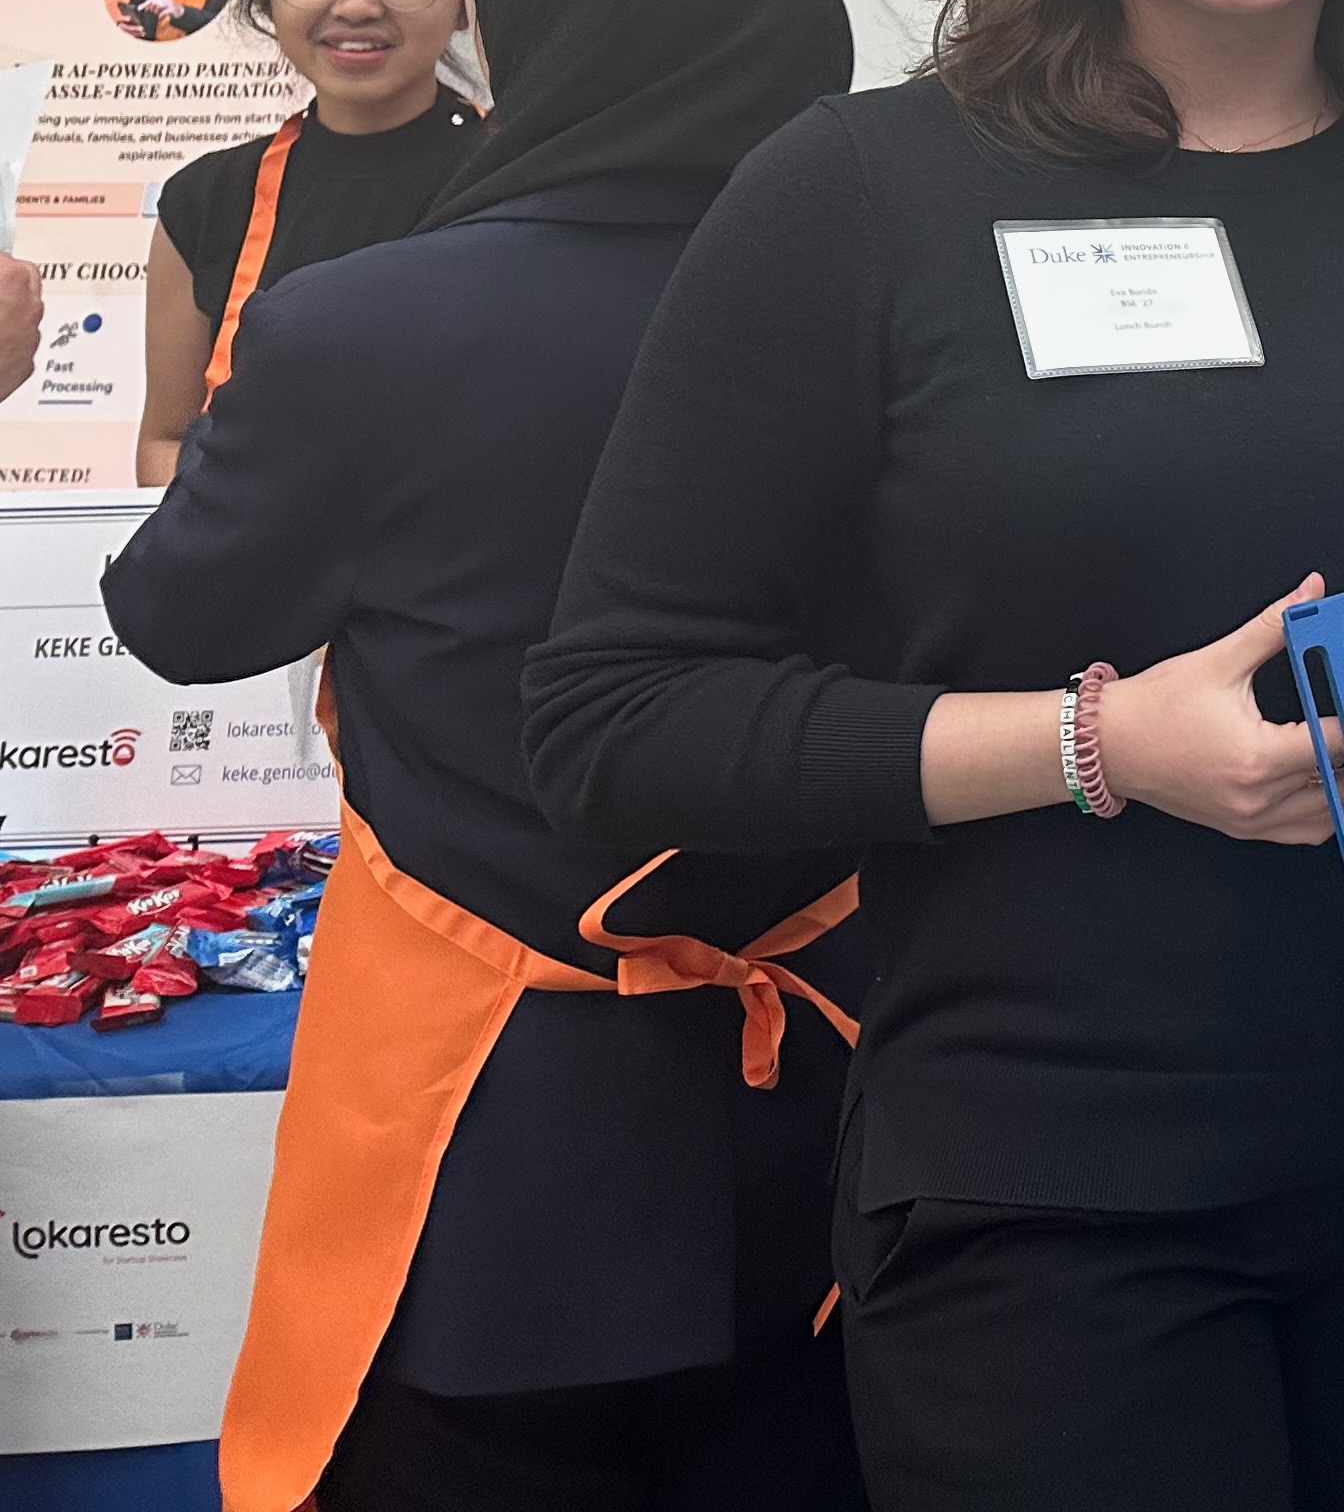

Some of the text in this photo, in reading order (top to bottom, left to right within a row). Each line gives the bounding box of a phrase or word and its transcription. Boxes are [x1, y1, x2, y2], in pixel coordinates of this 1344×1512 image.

[67, 62, 190, 79] AI-POWERED
[195, 61, 282, 79] PARTNER
[44, 81, 294, 100] ASSLE-FREE IMMIGRATION
[118, 149, 185, 162] aspirations.
[1028, 246, 1087, 265] Duke
[46, 360, 74, 373] Fast
[41, 379, 113, 396] Processing
[34, 637, 134, 659] KEKE GE
[12, 1218, 191, 1260] lokaresto
